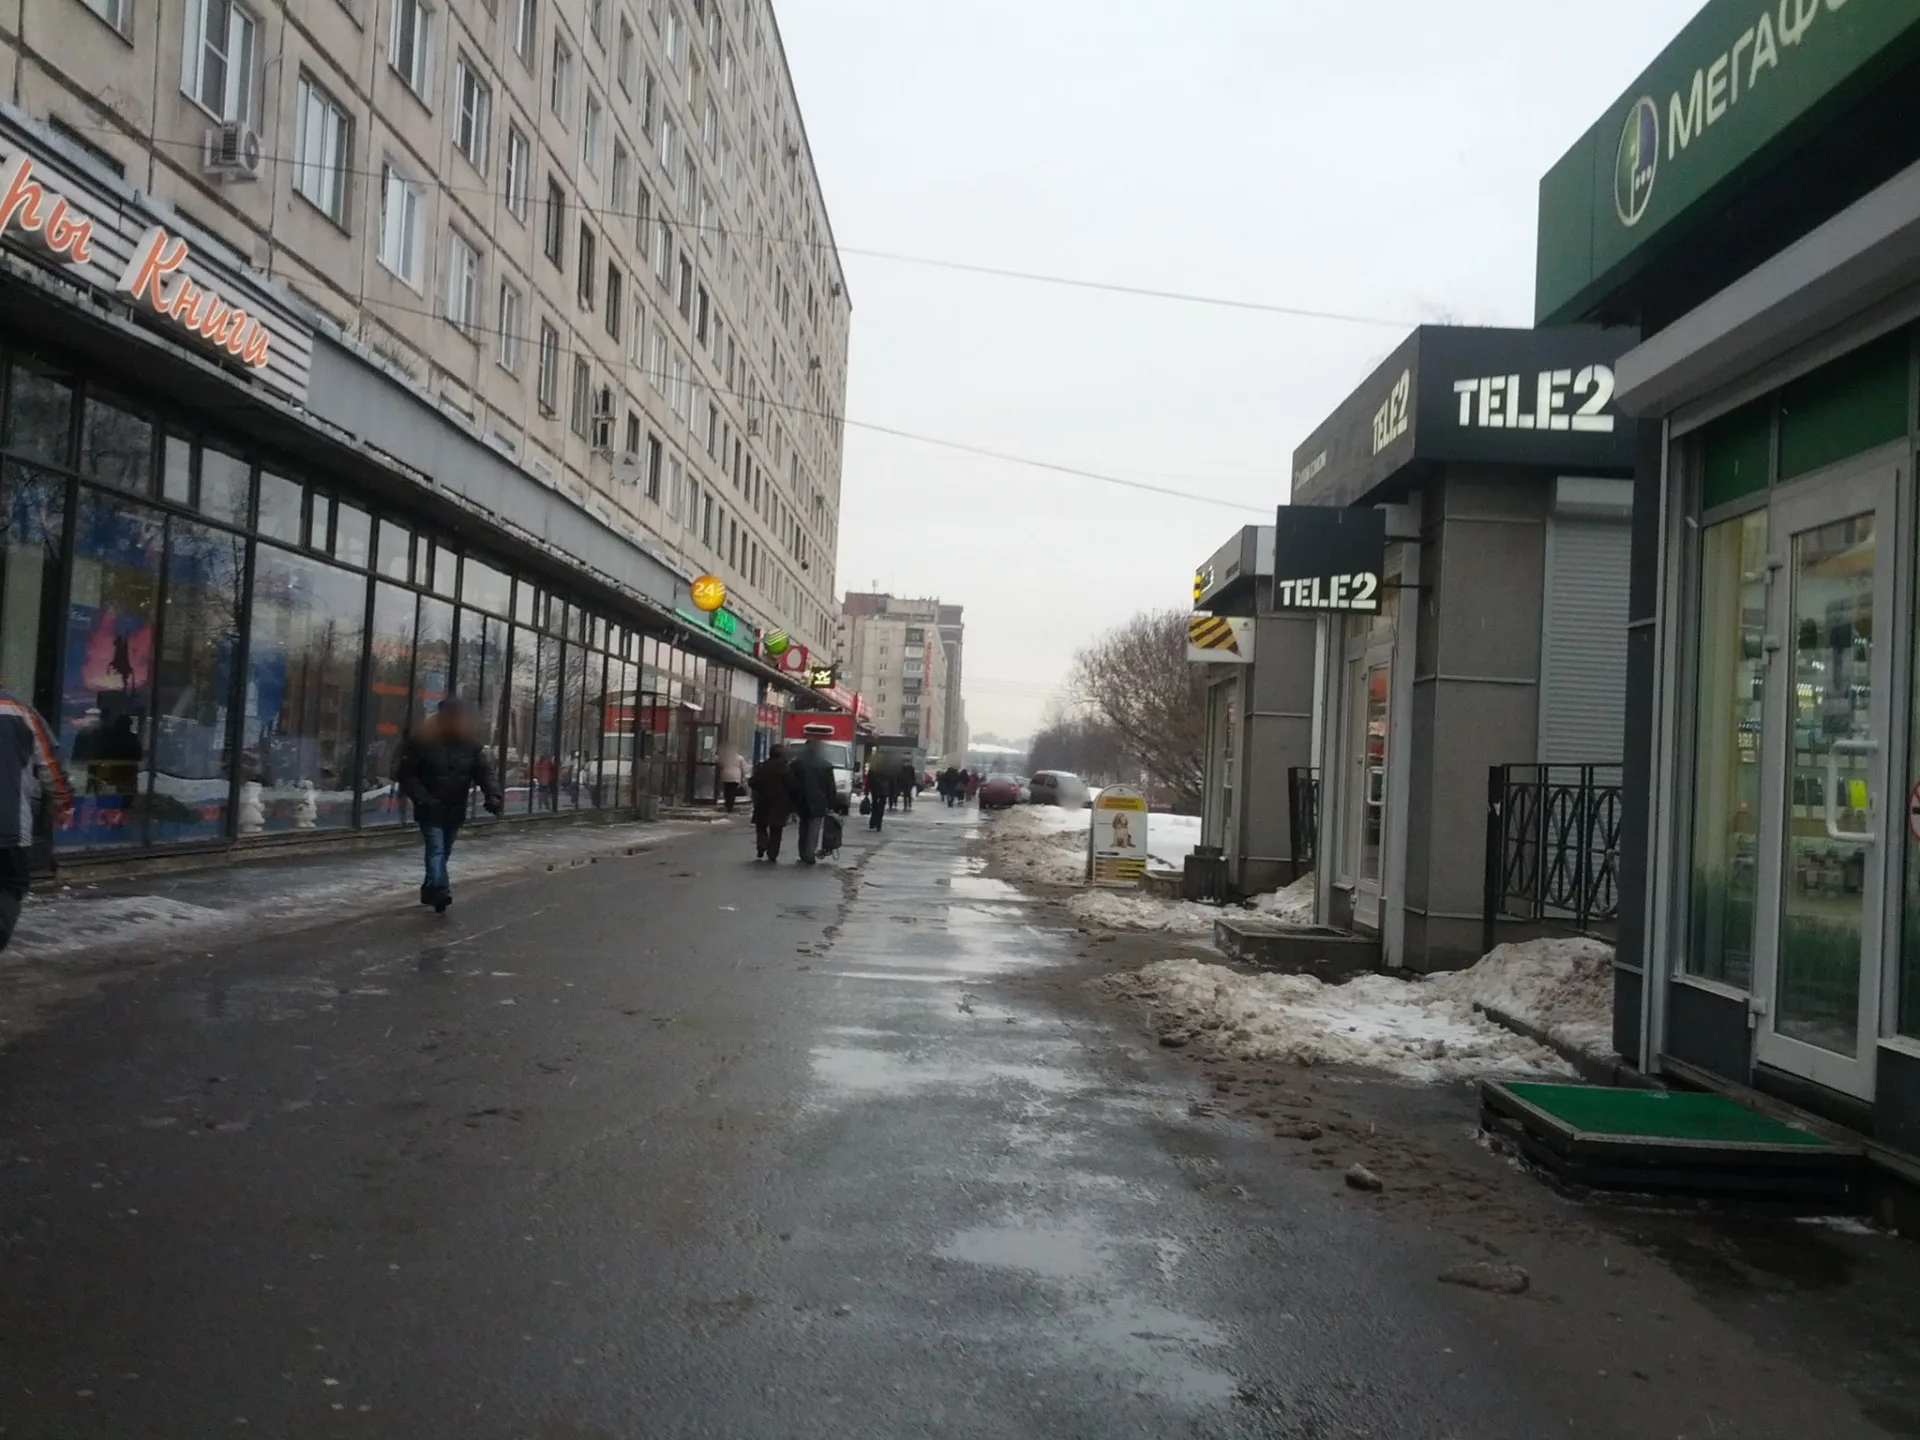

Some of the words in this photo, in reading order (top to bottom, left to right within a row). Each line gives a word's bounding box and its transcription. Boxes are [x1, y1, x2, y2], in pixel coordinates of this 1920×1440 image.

[1668, 0, 1846, 160] МЕГАФ
[130, 230, 270, 368] Книги
[1372, 369, 1410, 456] TELE2
[1453, 364, 1615, 432] TELE2
[694, 582, 716, 597] 24
[1280, 572, 1378, 609] TELE2
